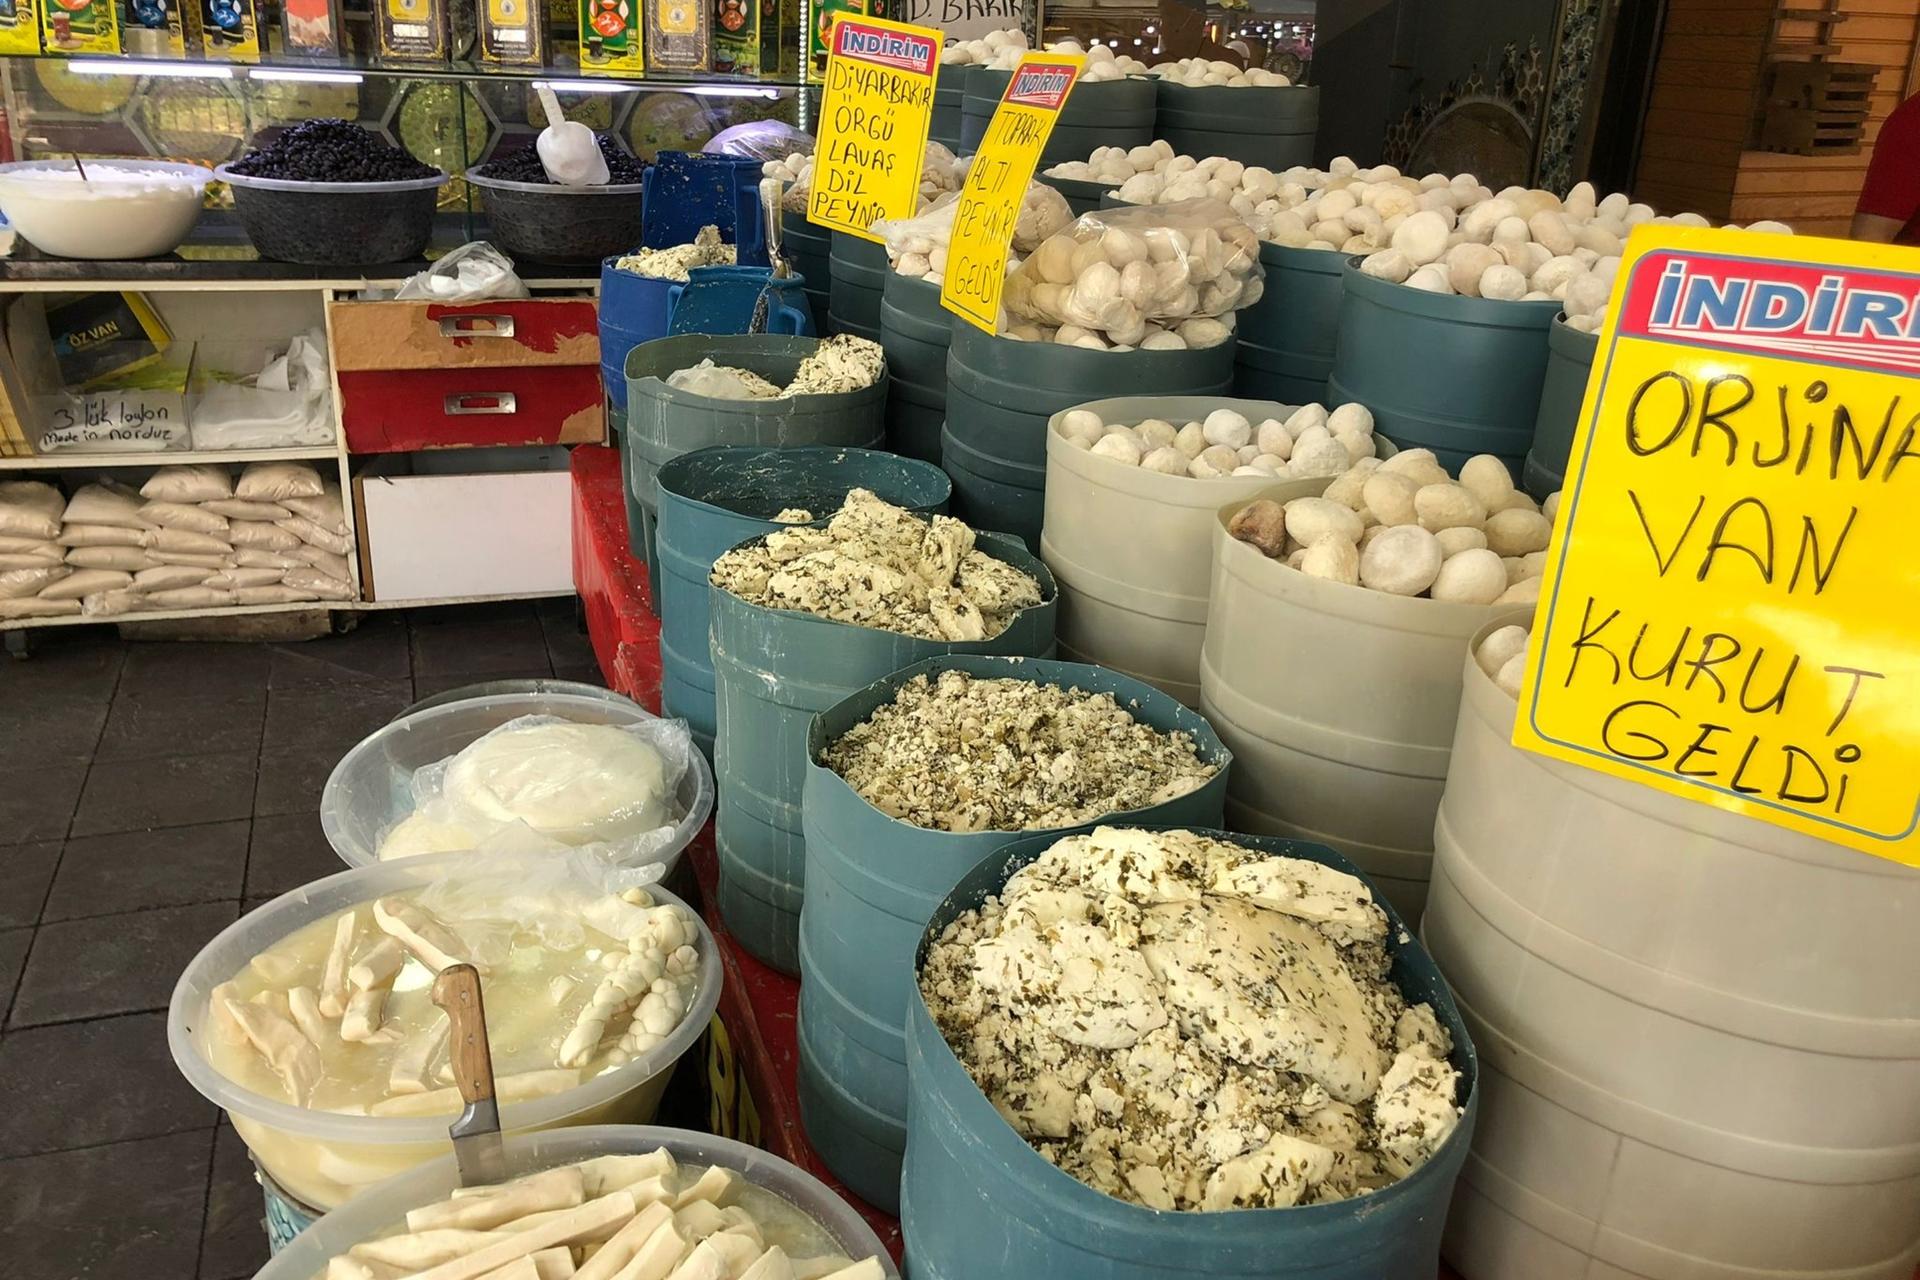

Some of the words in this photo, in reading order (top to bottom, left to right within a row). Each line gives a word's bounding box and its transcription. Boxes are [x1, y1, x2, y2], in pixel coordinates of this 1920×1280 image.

[841, 24, 930, 61] İNDİRİM
[835, 93, 894, 141] ÖRGÜ
[828, 139, 896, 177] LAVAŞ
[88, 320, 119, 340] VAN
[53, 408, 75, 430] 3
[83, 429, 98, 441] in
[1628, 489, 1858, 596] VAN
